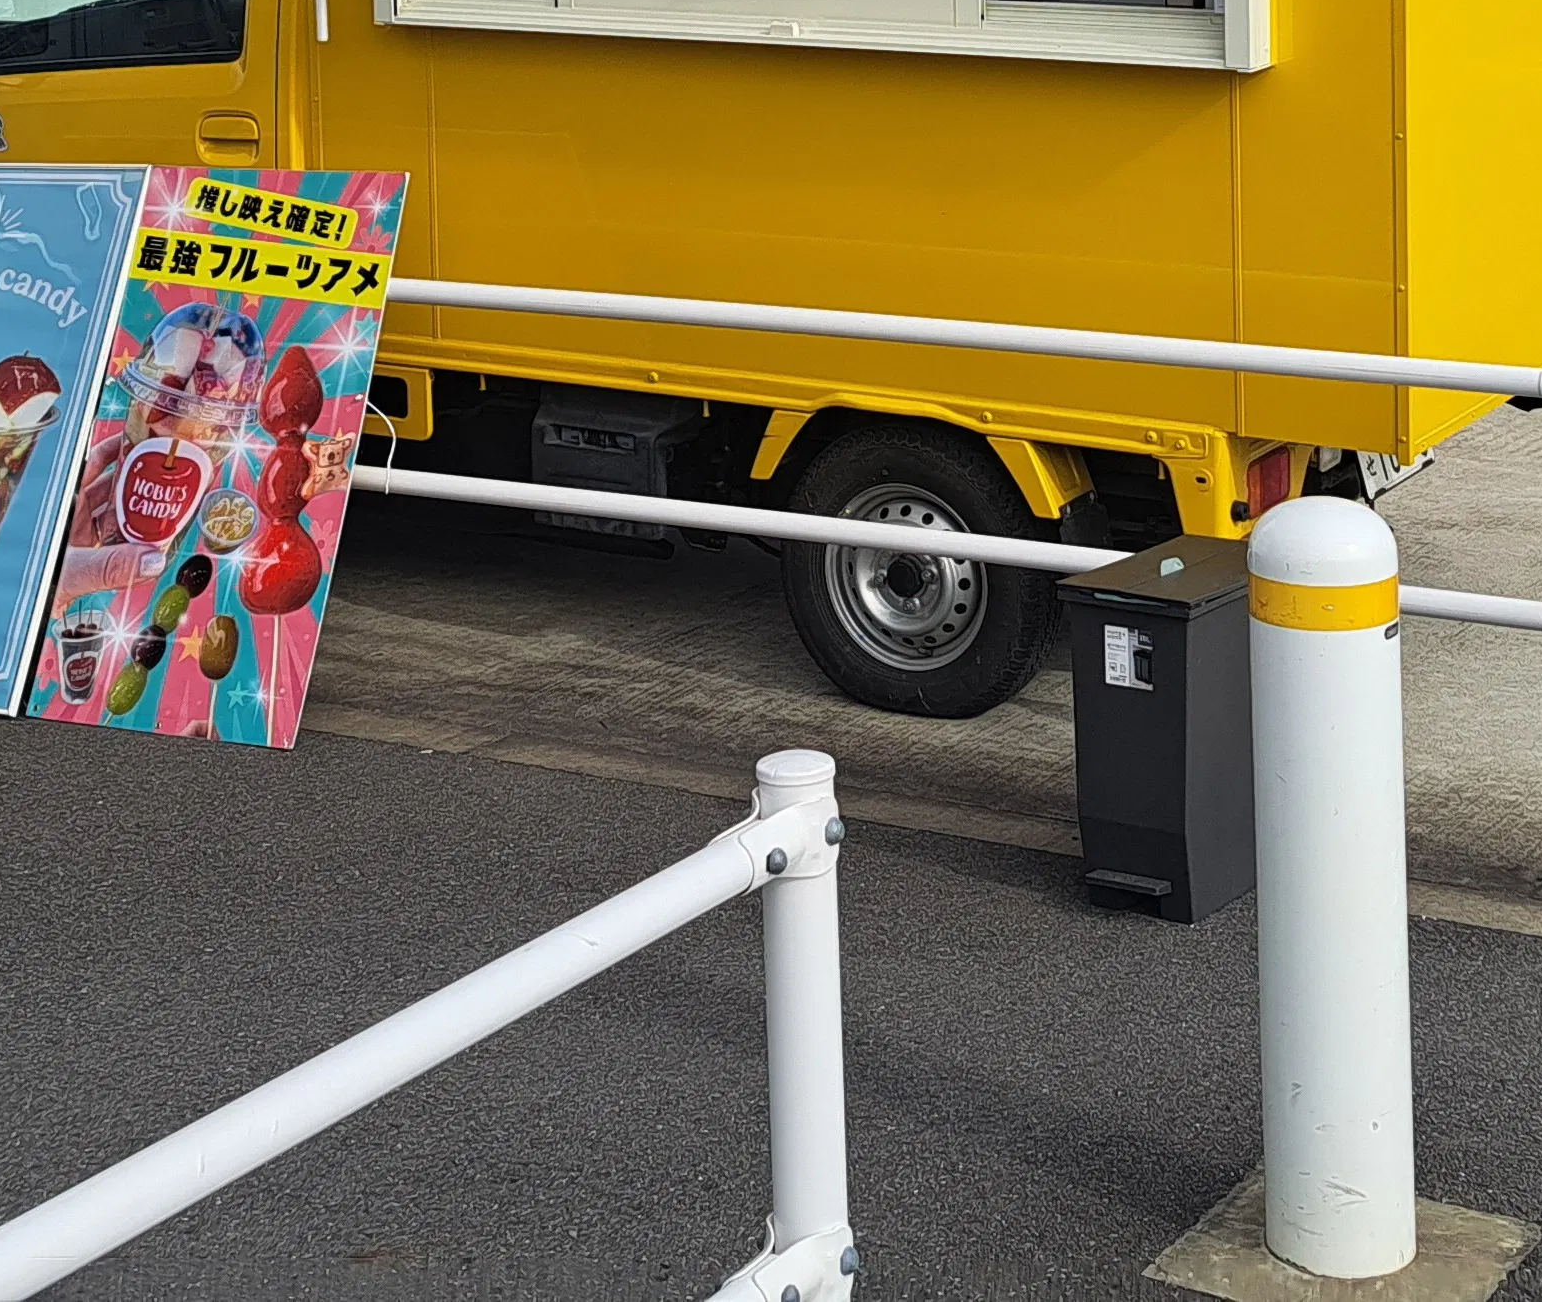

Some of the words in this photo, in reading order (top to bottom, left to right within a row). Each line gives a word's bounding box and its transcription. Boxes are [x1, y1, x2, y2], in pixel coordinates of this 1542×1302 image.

[195, 185, 348, 242] 推し映え確定!
[137, 236, 380, 297] 最強フルーツアメ
[129, 496, 182, 520] CANDY
[133, 477, 188, 502] NOBU'S
